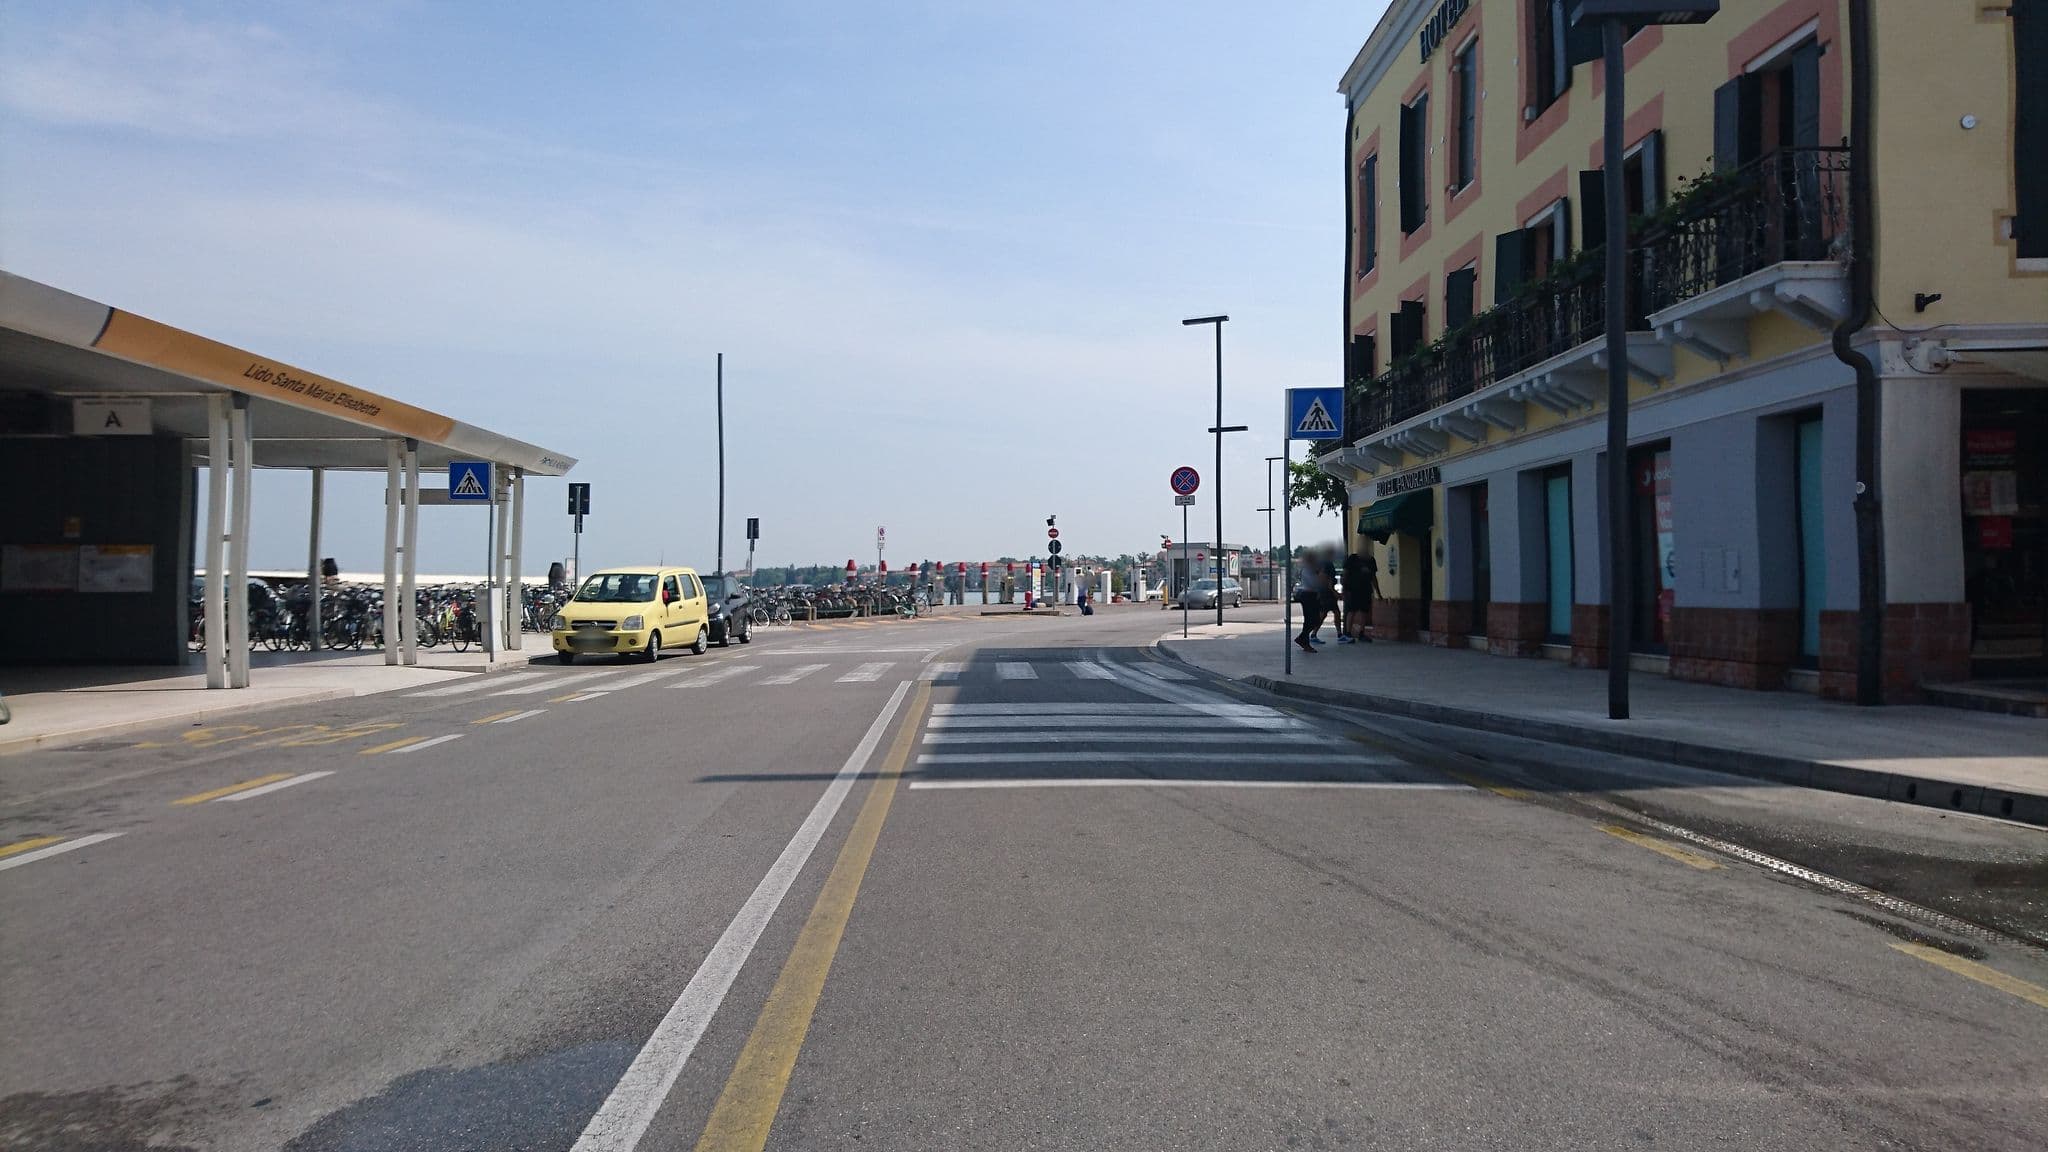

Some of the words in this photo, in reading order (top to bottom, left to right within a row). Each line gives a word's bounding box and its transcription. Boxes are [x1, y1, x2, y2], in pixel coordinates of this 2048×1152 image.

[243, 363, 274, 383] Lido
[272, 372, 306, 393] Santa
[304, 383, 336, 402] Maria
[334, 392, 381, 417] Elisabetta
[104, 410, 122, 428] A
[1376, 478, 1397, 497] HOTEL
[1398, 467, 1438, 492] PANORAMA
